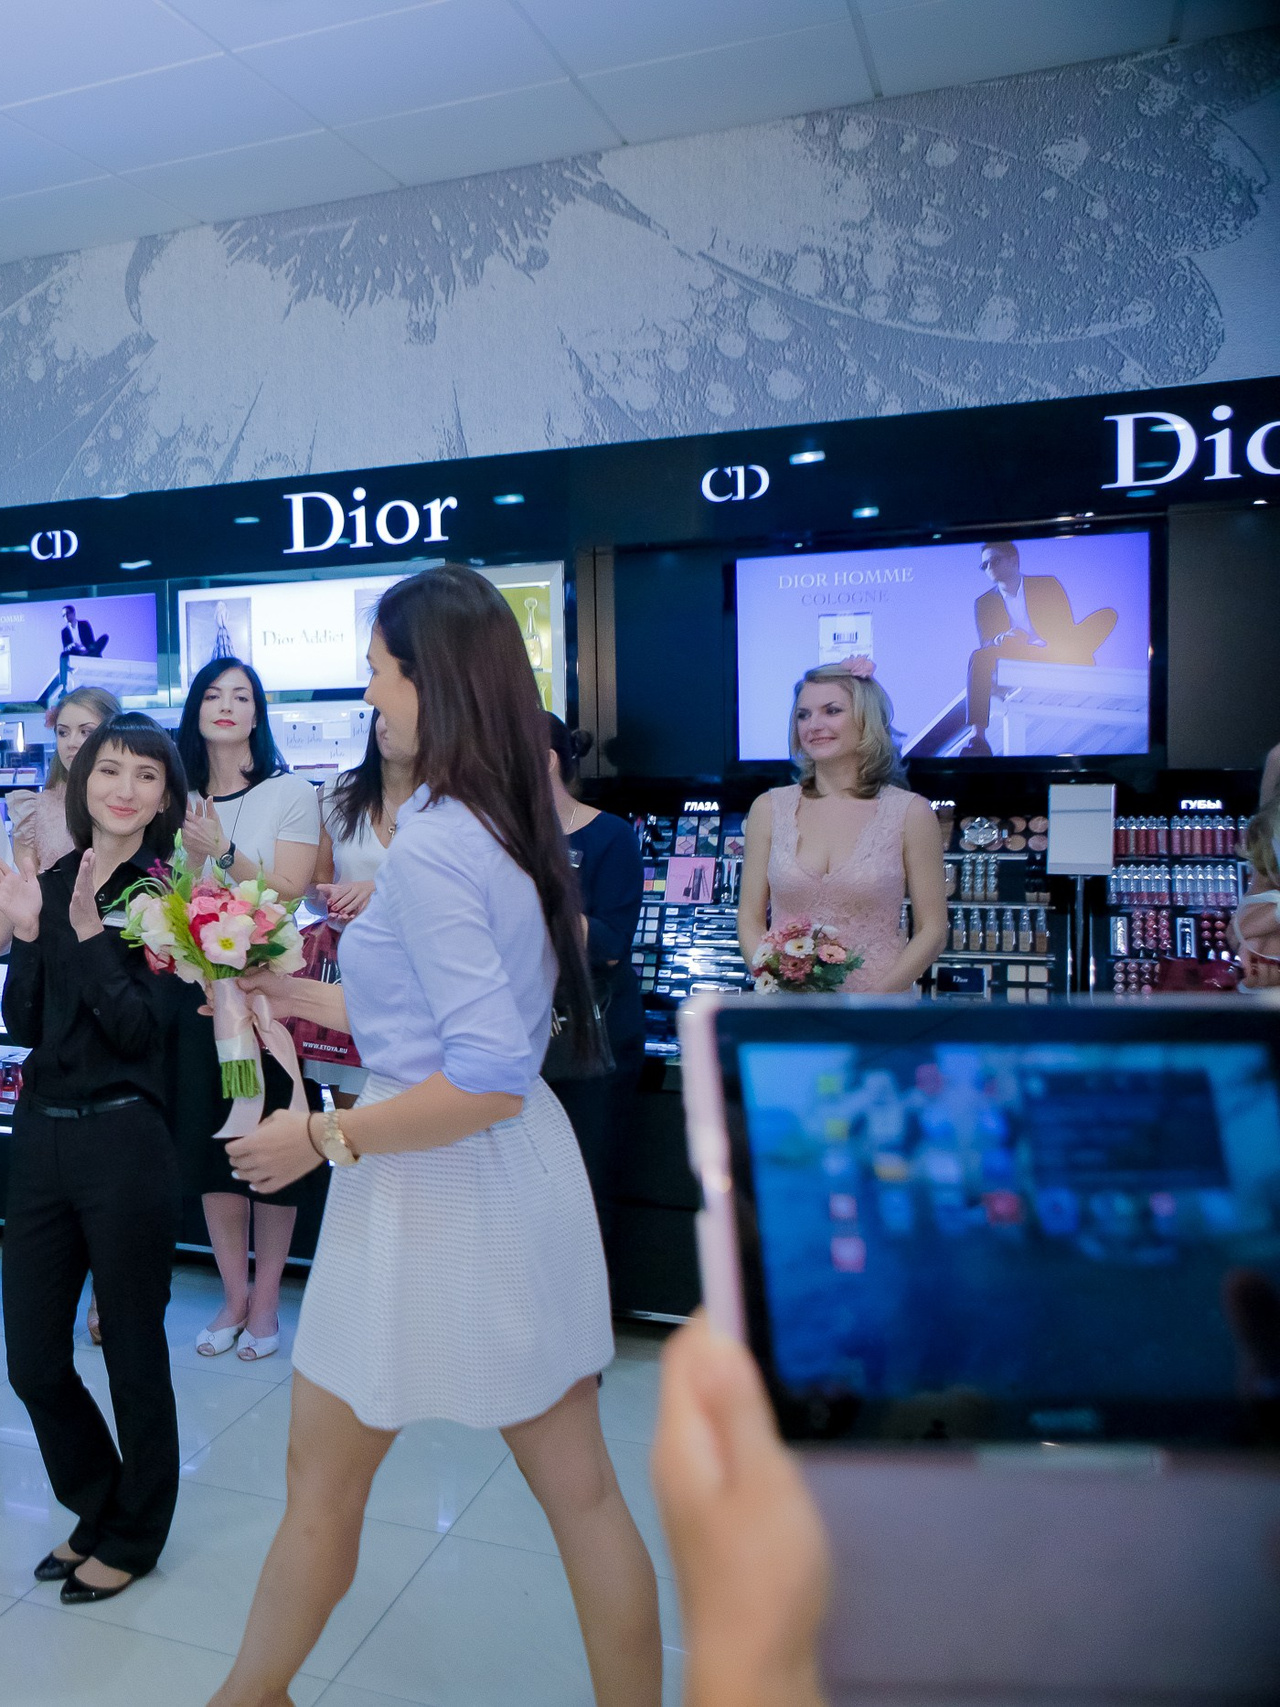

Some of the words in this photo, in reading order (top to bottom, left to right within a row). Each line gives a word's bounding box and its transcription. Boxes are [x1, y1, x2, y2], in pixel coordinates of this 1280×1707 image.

[282, 486, 458, 554] Dior
[778, 572, 828, 589] DIOR
[834, 567, 915, 586] HOMME
[801, 589, 890, 606] COLOGNE
[262, 630, 296, 646] Dior
[301, 629, 344, 644] Addict
[684, 801, 720, 811] ГЛАЗА
[1180, 799, 1223, 810] ГУБЫ
